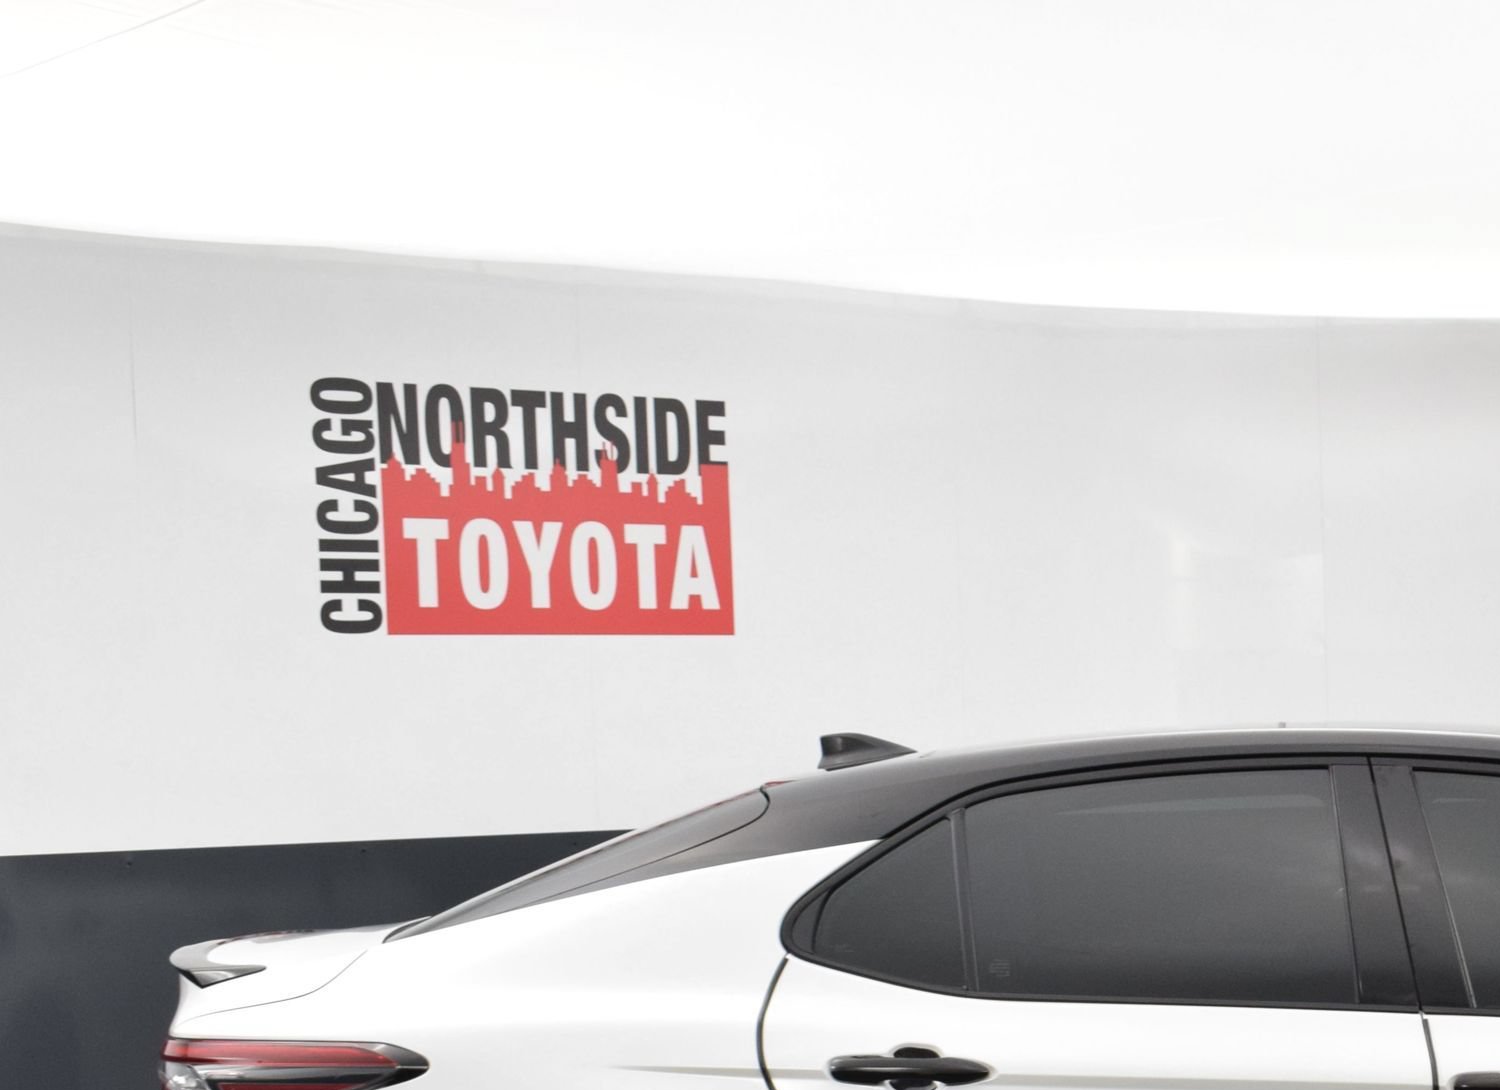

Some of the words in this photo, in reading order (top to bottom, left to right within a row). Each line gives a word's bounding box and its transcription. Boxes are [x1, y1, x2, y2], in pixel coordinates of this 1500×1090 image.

[376, 381, 728, 476] NORTHSIDE
[310, 377, 383, 634] CHICAGO
[402, 517, 721, 611] TOYOTA
